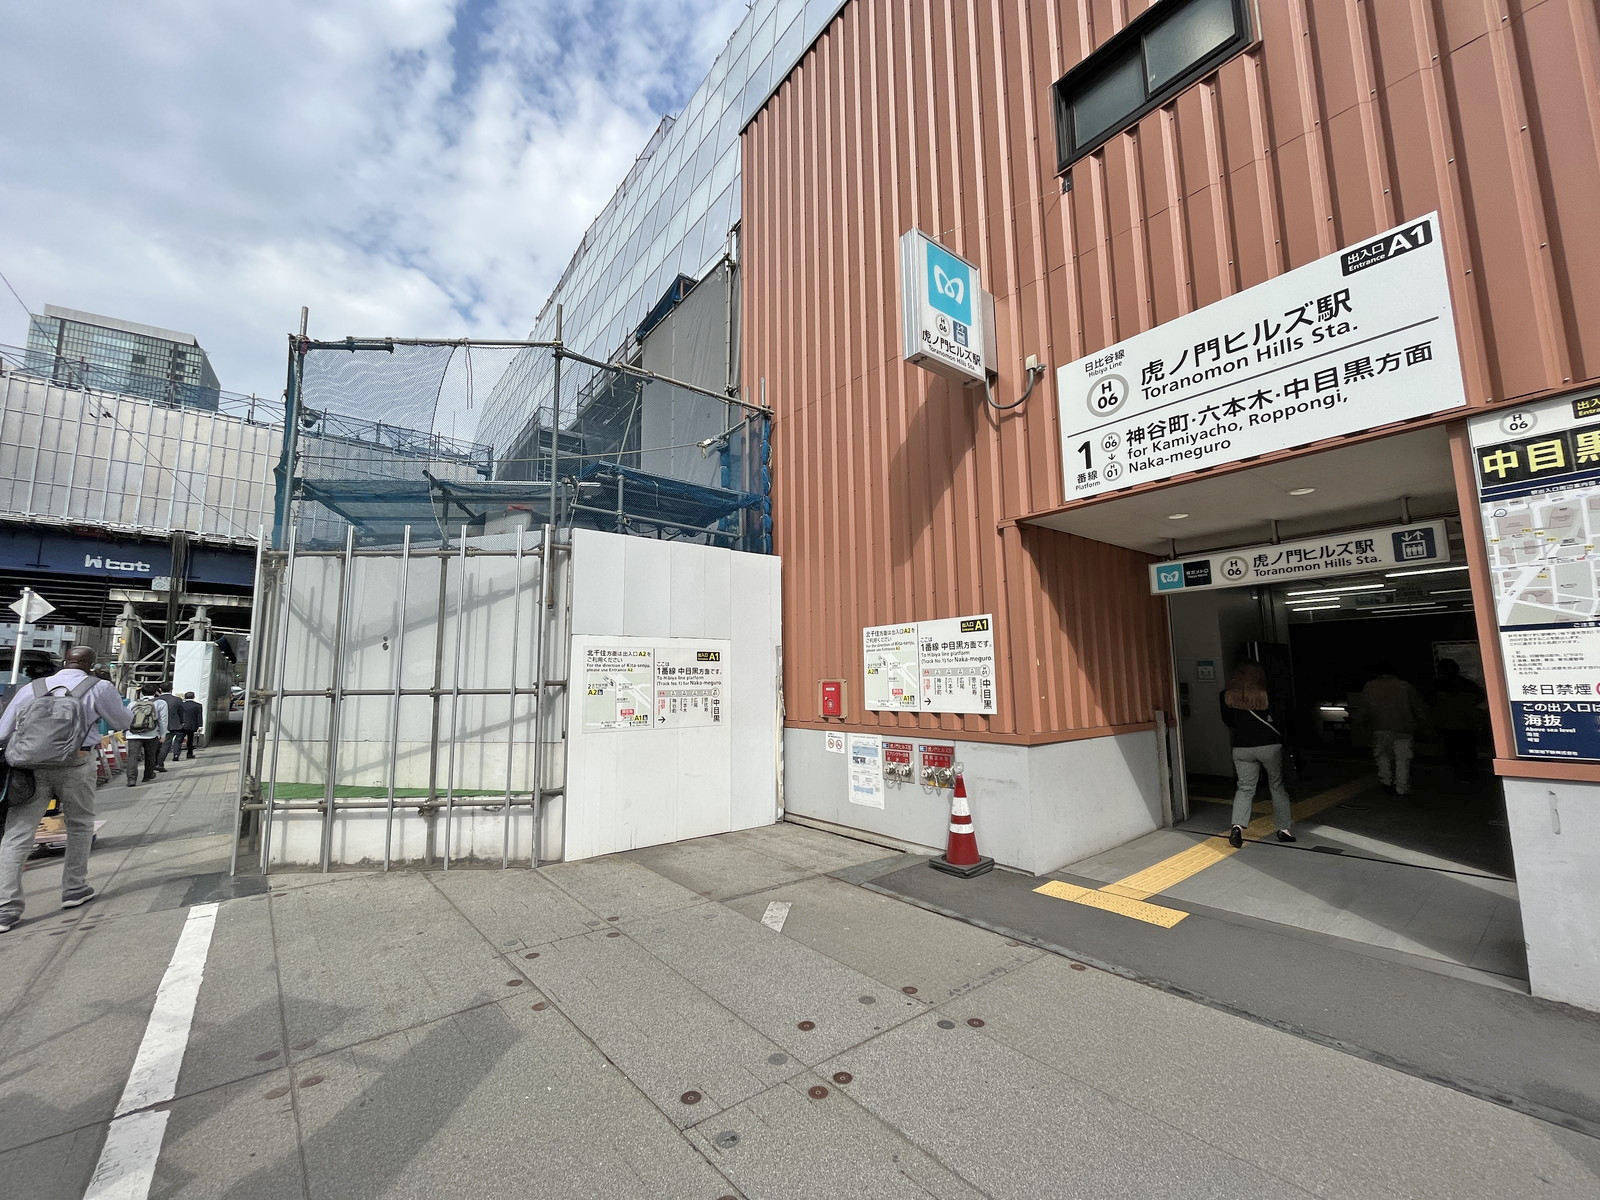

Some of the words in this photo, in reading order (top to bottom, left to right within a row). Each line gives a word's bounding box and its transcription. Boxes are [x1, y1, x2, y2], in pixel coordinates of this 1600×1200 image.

[1388, 224, 1425, 257] A1
[1348, 242, 1384, 264] 出入口
[1348, 254, 1386, 272] Entrance
[939, 324, 948, 332] 06
[1141, 288, 1353, 386] 虎ノ門ヒルズ駅
[922, 329, 982, 366] 虎ノ門ヒルズ駅
[928, 344, 956, 362] Toranomon
[1085, 350, 1126, 373] 日比谷線
[1088, 366, 1108, 378] Hibiya
[1109, 360, 1123, 370] Line
[1142, 356, 1249, 400] Toranomon
[1256, 337, 1304, 363] Hills
[1312, 322, 1358, 344] Sta.
[1101, 381, 1112, 394] H
[1098, 392, 1119, 409] 06
[1127, 446, 1148, 460] for
[1152, 422, 1244, 454] Kamiyacho,
[1249, 390, 1348, 427] Roppongi,
[1510, 420, 1528, 431] 06
[1512, 414, 1522, 422] H
[1104, 440, 1117, 449] 06
[1078, 441, 1092, 470] 1
[1128, 438, 1231, 474] Naka-meguro
[1077, 470, 1098, 484] 番線
[1106, 468, 1118, 478] 01
[1076, 480, 1100, 491] Platform
[1253, 538, 1375, 568] 虎ノ門ヒルズ駅
[1228, 568, 1242, 576] 06
[1254, 563, 1320, 577] Toranomon
[1324, 558, 1352, 568] Hills
[1356, 554, 1382, 565] Sta.
[975, 620, 987, 630] A1
[983, 679, 992, 709] 中目黒
[1522, 684, 1592, 695] 終日禁煙
[1524, 714, 1562, 727] 海抜
